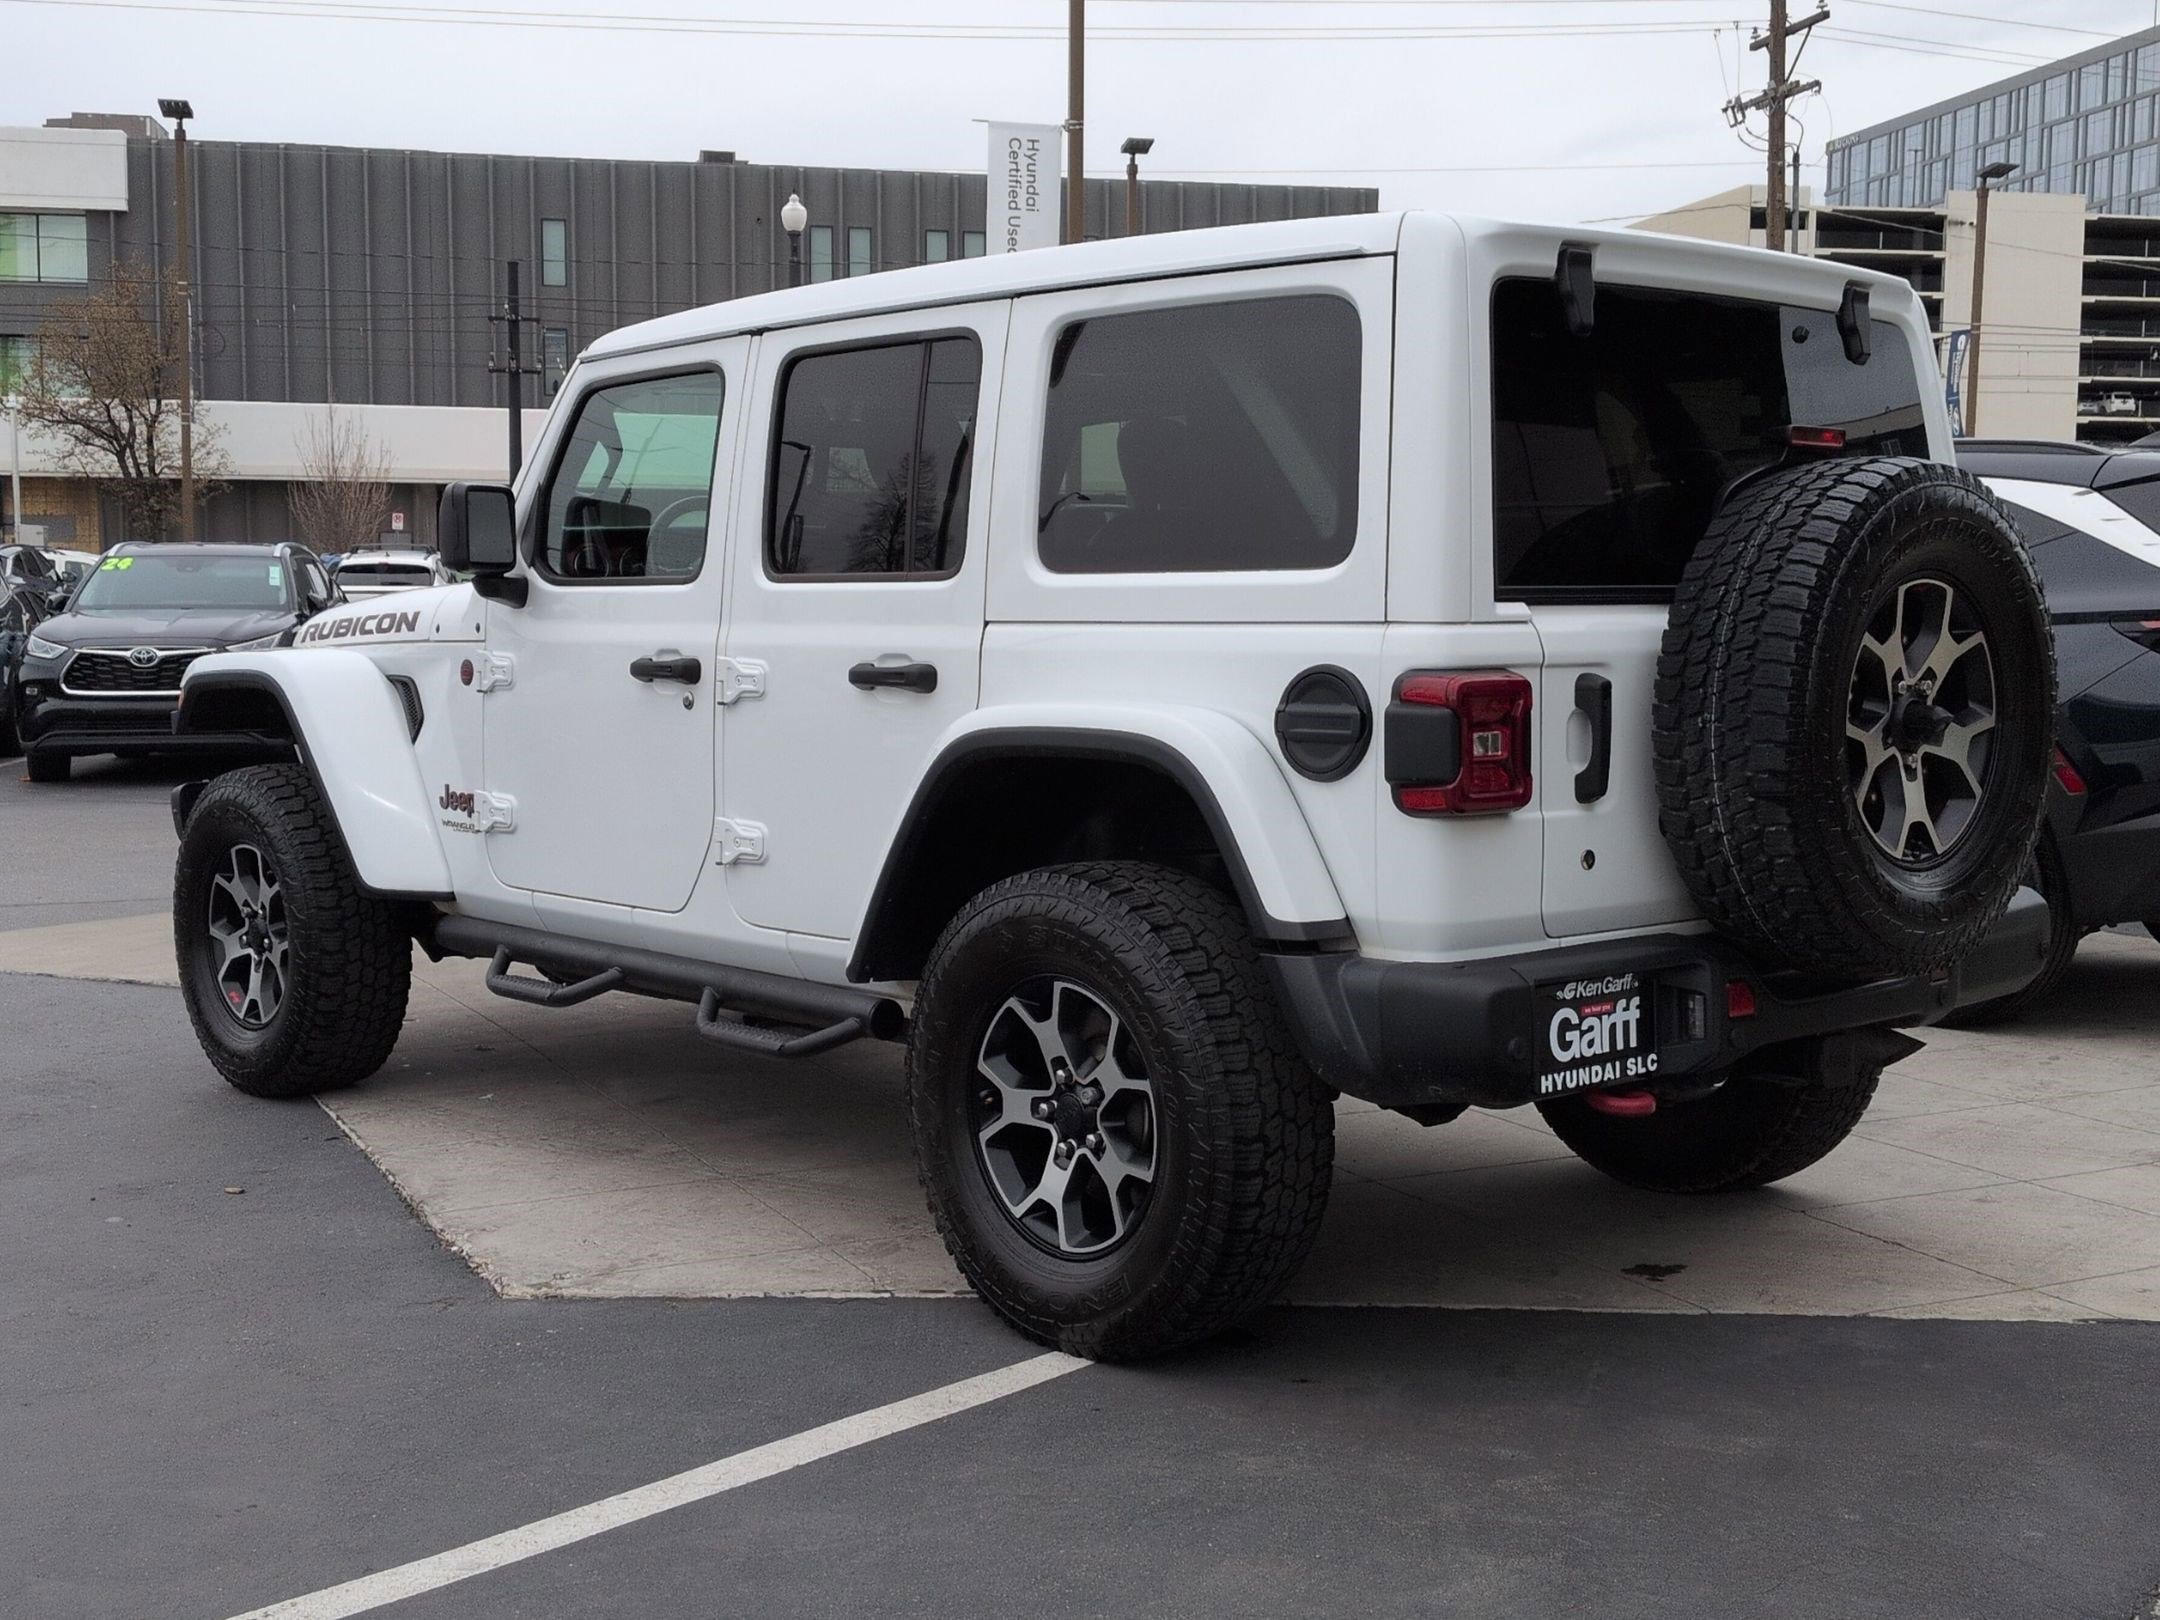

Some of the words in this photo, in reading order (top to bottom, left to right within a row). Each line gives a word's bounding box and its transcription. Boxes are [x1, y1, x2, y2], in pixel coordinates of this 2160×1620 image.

[1007, 138, 1022, 211] Certified
[1023, 139, 1040, 212] Hyundai
[301, 610, 421, 643] RUBICON
[439, 783, 475, 818] Jeep
[1576, 980, 1602, 999] Ken
[1603, 972, 1633, 994] Garff
[1549, 996, 1641, 1063] Garff
[1540, 1060, 1621, 1094] HYUNDAI
[1626, 1053, 1658, 1077] SLC
